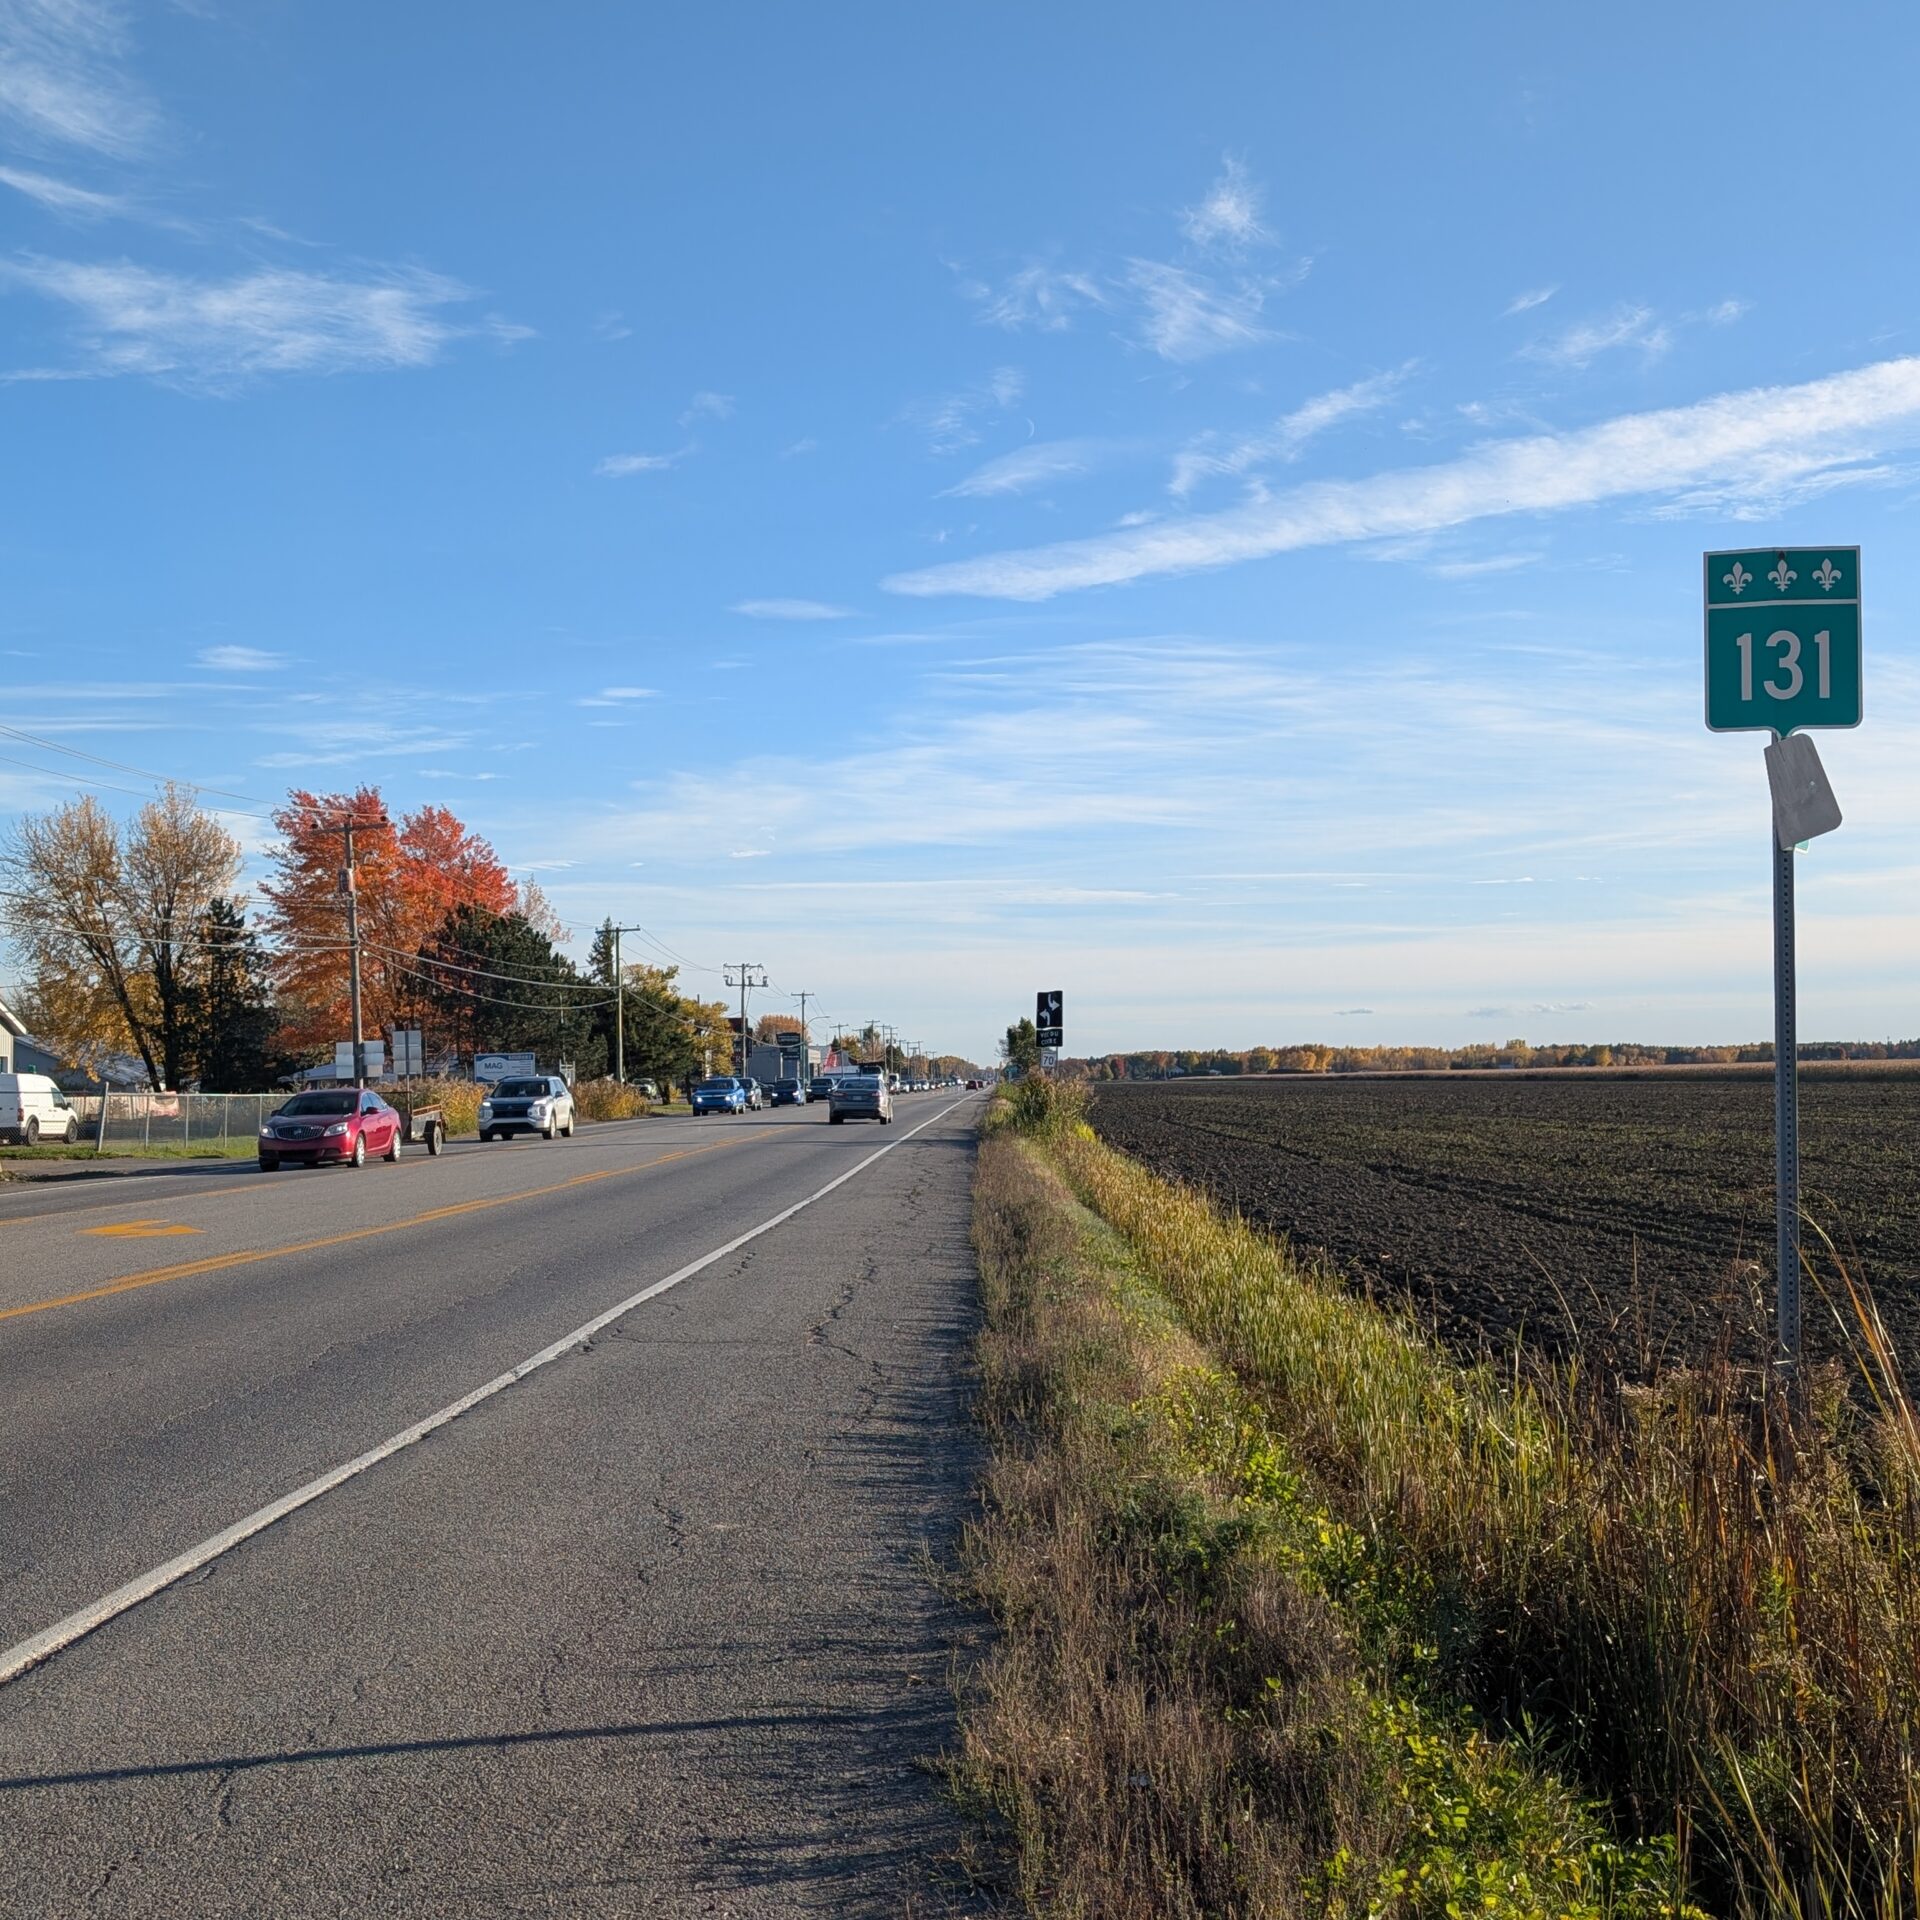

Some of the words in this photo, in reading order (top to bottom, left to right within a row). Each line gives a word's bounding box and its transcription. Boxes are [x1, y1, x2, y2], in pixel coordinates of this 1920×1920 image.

[1736, 629, 1830, 701] 131
[1043, 1056, 1054, 1065] 70
[484, 1062, 503, 1070] MAG
